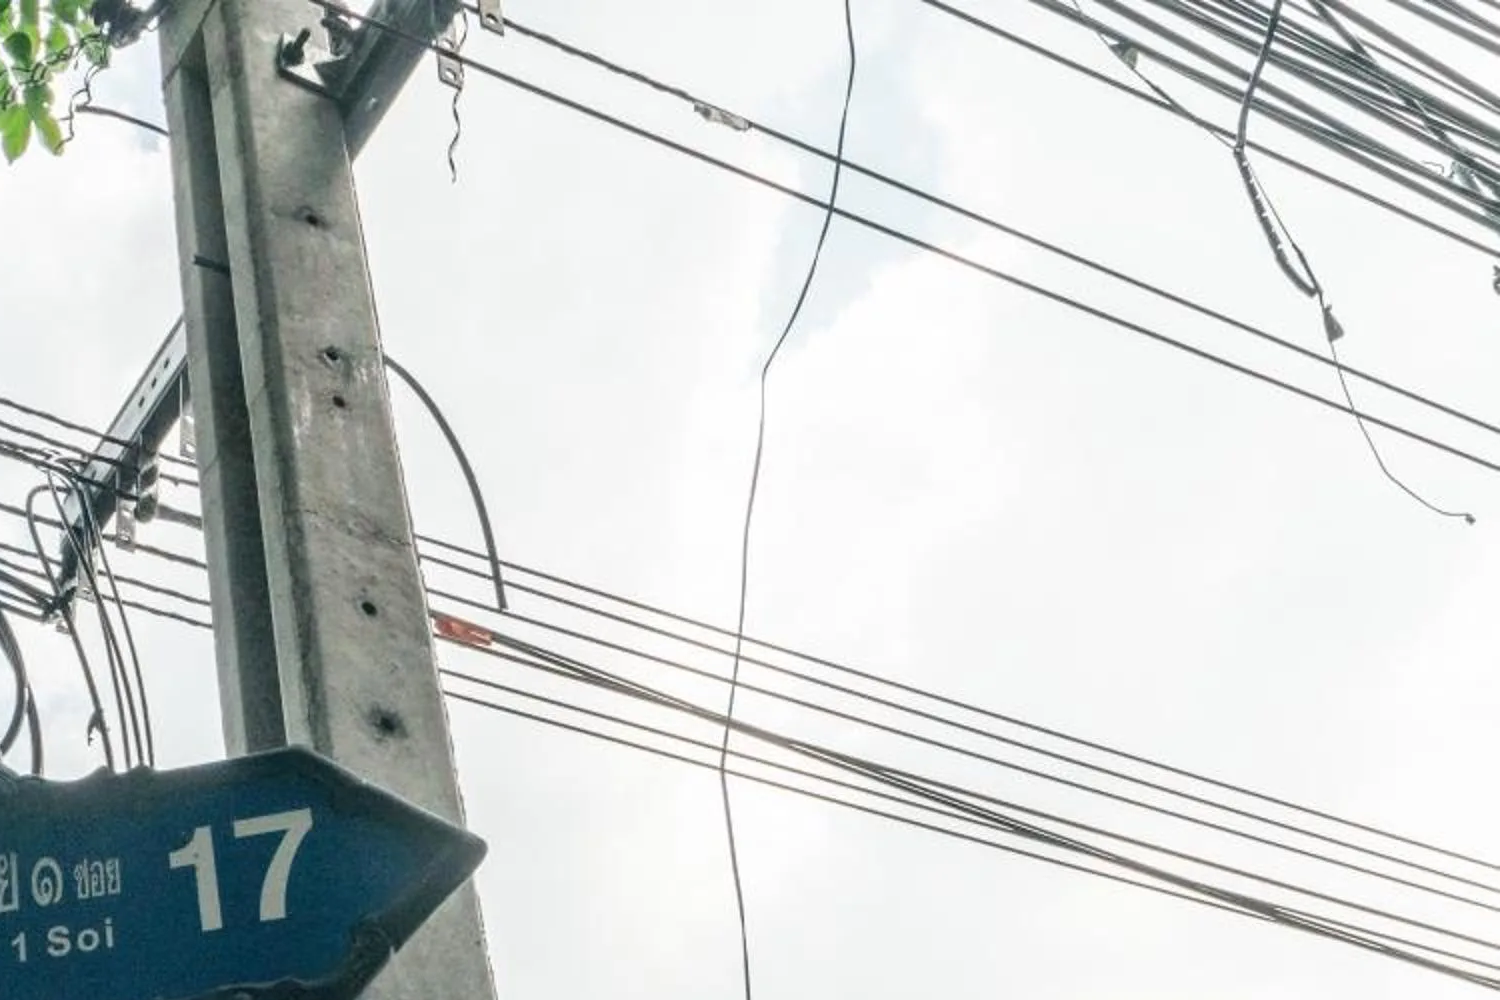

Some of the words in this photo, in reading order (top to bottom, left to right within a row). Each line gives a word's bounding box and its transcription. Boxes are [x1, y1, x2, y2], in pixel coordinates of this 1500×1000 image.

[168, 807, 313, 933] 17
[11, 931, 28, 963] 1
[47, 916, 115, 958] Soi
